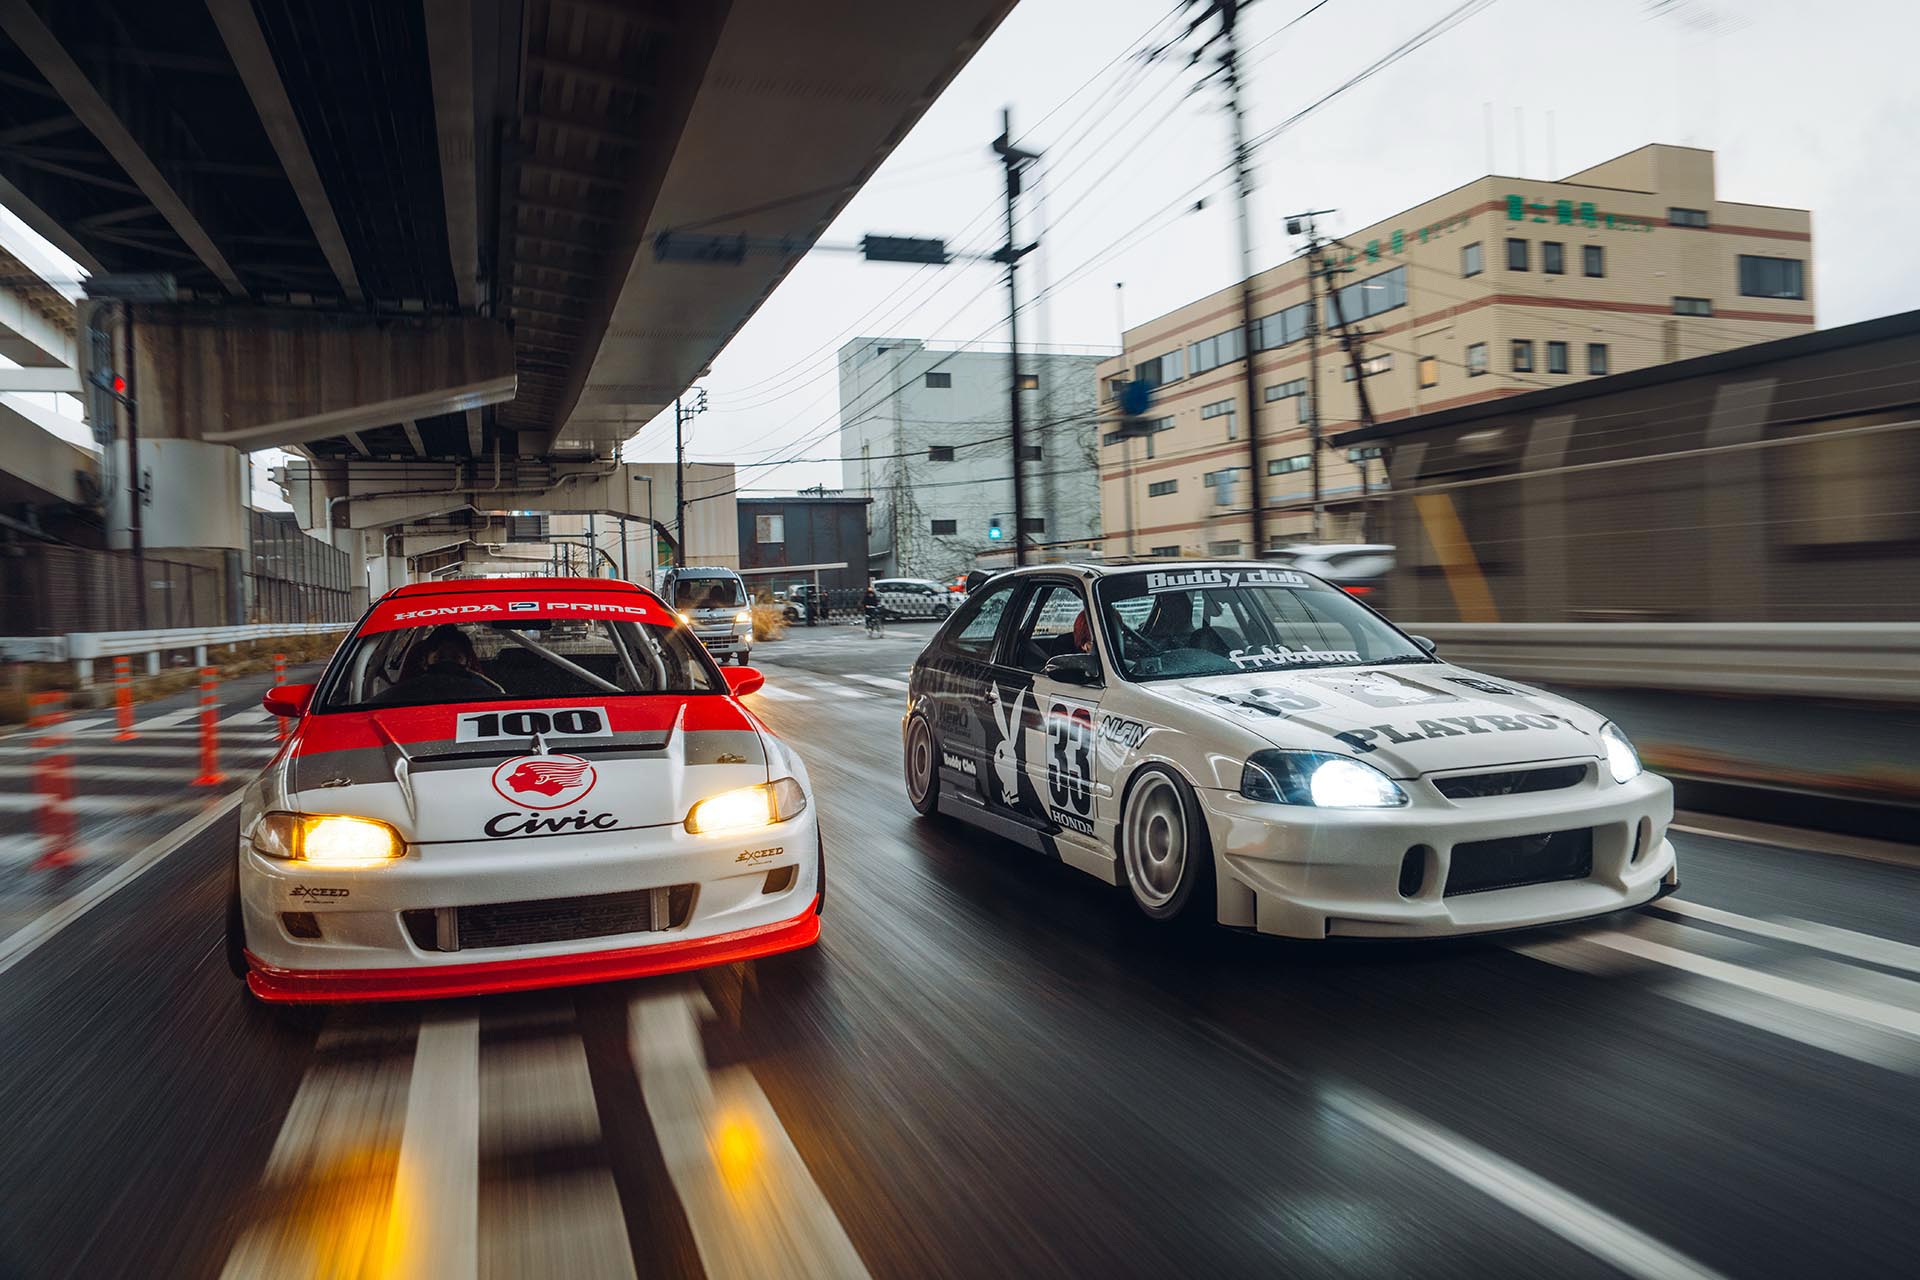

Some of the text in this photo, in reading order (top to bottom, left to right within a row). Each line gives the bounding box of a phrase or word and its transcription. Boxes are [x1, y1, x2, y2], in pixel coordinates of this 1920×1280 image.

[1146, 570, 1240, 588] Buddy
[393, 603, 503, 621] HONDA
[546, 602, 647, 615] PRIMO
[463, 709, 603, 738] 100
[1047, 703, 1092, 816] 33
[484, 810, 619, 837] Civic
[1051, 809, 1095, 836] HONDA
[735, 847, 784, 863] EXCEED
[289, 884, 350, 900] EXCEED
